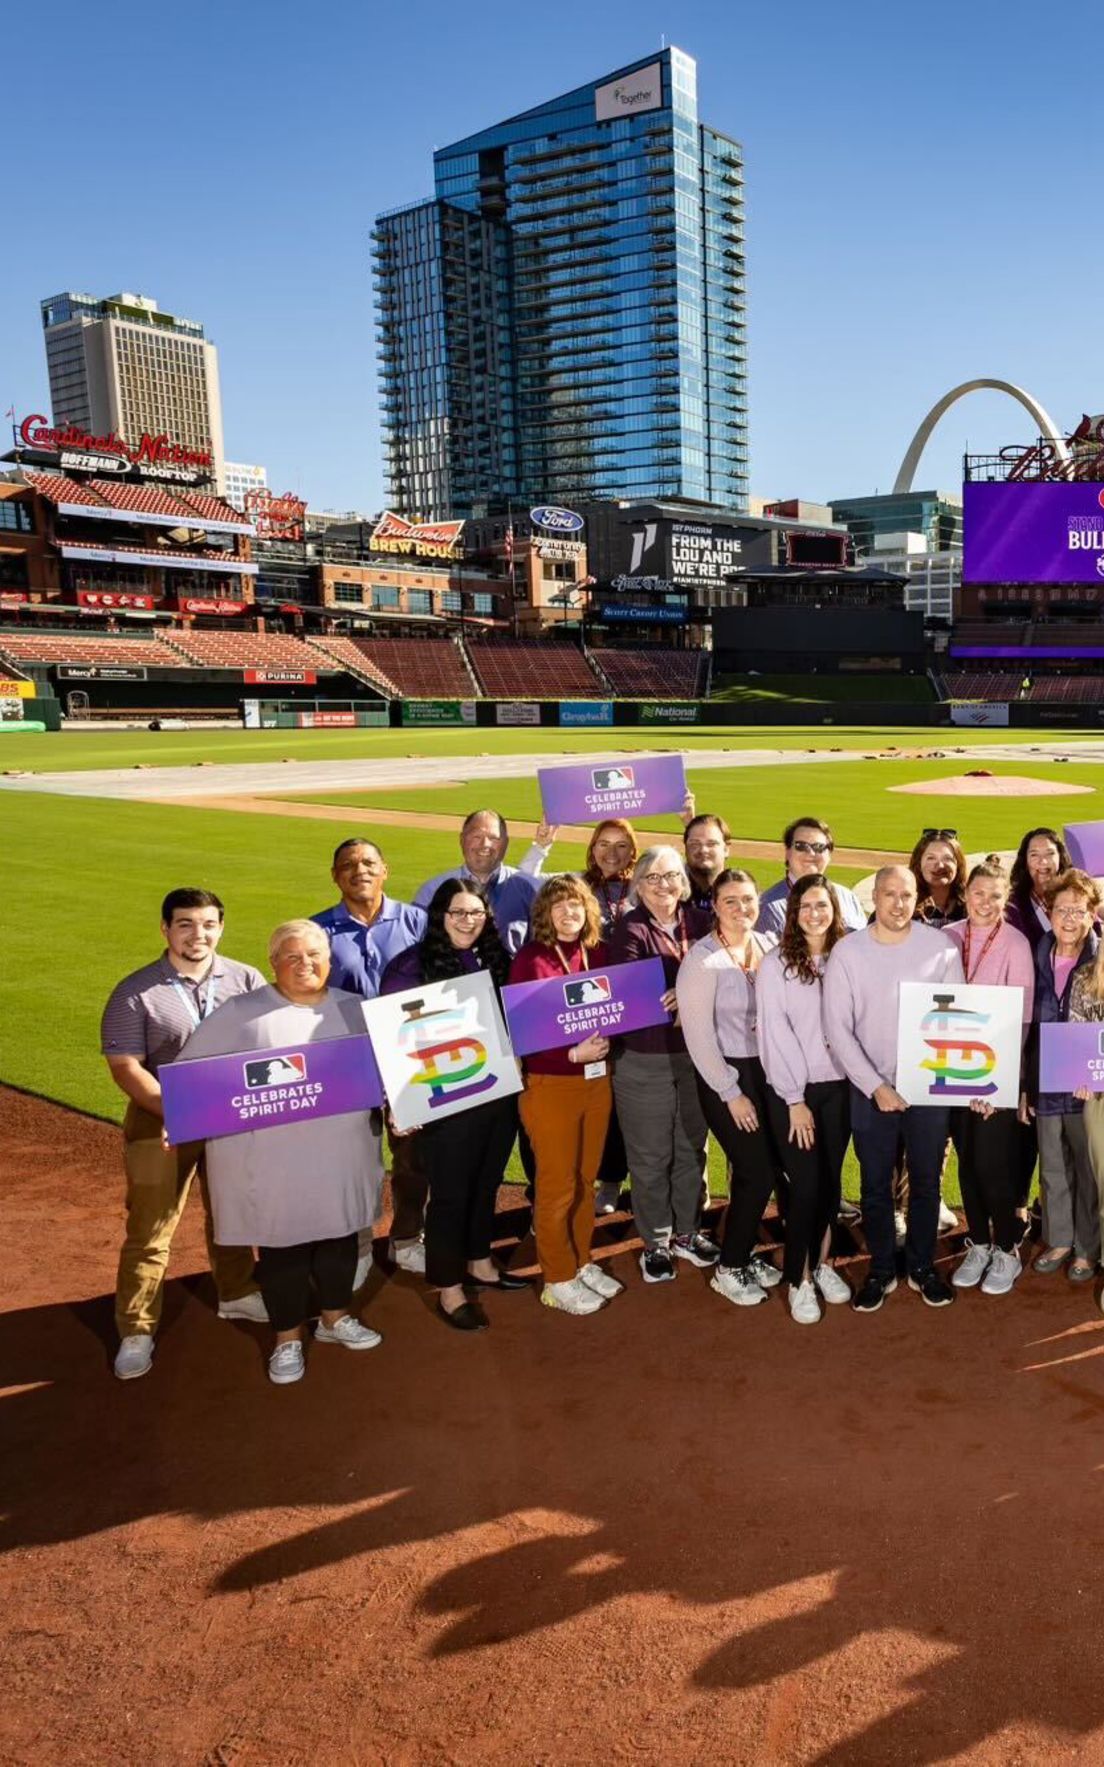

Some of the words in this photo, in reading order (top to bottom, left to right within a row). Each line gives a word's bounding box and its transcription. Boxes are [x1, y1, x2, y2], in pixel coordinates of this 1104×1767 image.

[621, 91, 651, 105] Together
[20, 414, 129, 454] Cardinals
[130, 433, 212, 465] Nation
[61, 452, 120, 471] HOFFMANN
[140, 466, 197, 482] ROOFTOP
[542, 510, 573, 527] Ford
[373, 520, 462, 541] Budweiser
[370, 537, 412, 554] BREW
[416, 544, 465, 559] HOUSE
[672, 533, 712, 550] FROM
[716, 538, 742, 552] THE
[672, 547, 700, 562] LOU
[703, 550, 733, 565] AND
[672, 560, 719, 577] WE'RE
[68, 668, 91, 678] Mercy
[267, 672, 303, 680] PURINA
[655, 707, 697, 717] National
[584, 789, 646, 804] CELEBRATES
[590, 802, 621, 813] SPIRIT
[624, 800, 643, 809] DAY
[557, 1001, 625, 1025] CELEBRATES
[564, 1018, 600, 1035] SPIRIT
[601, 1013, 622, 1027] DAY
[231, 1082, 323, 1107] CELEBRATES
[239, 1100, 286, 1119] SPIRIT
[290, 1095, 318, 1111] DAY
